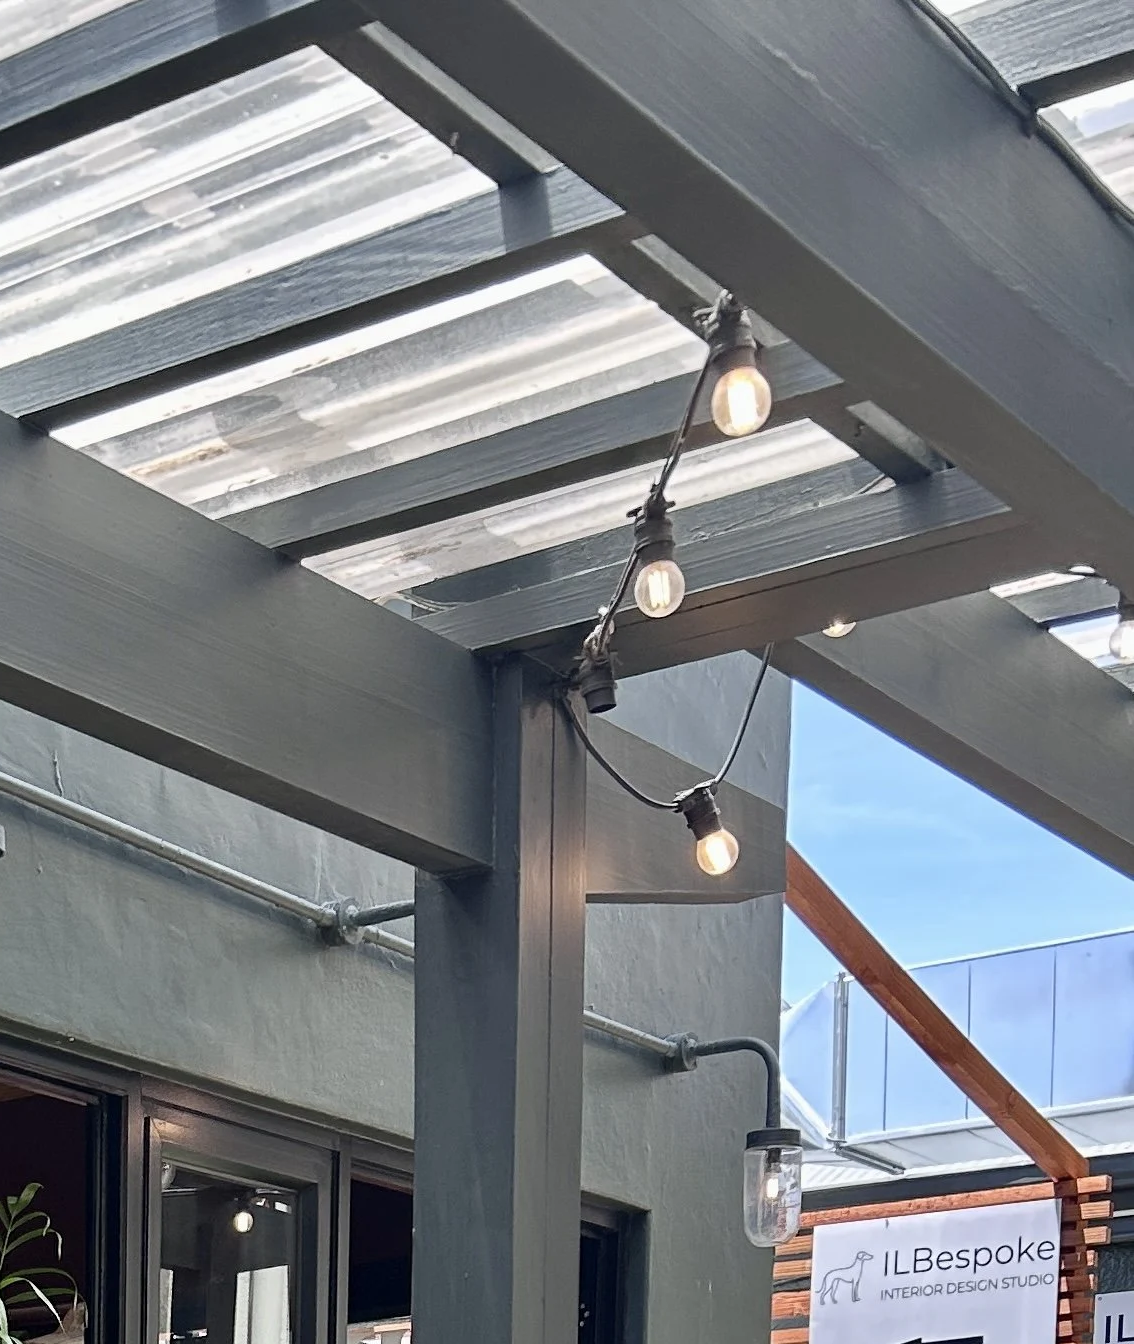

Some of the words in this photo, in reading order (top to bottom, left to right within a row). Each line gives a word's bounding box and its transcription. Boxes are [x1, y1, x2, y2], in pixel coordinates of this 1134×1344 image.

[883, 1235, 1055, 1277] ILBespoke
[880, 1284, 942, 1302] INTERIOR
[946, 1278, 998, 1295] DESIGN
[1001, 1273, 1054, 1290] STUDIO
